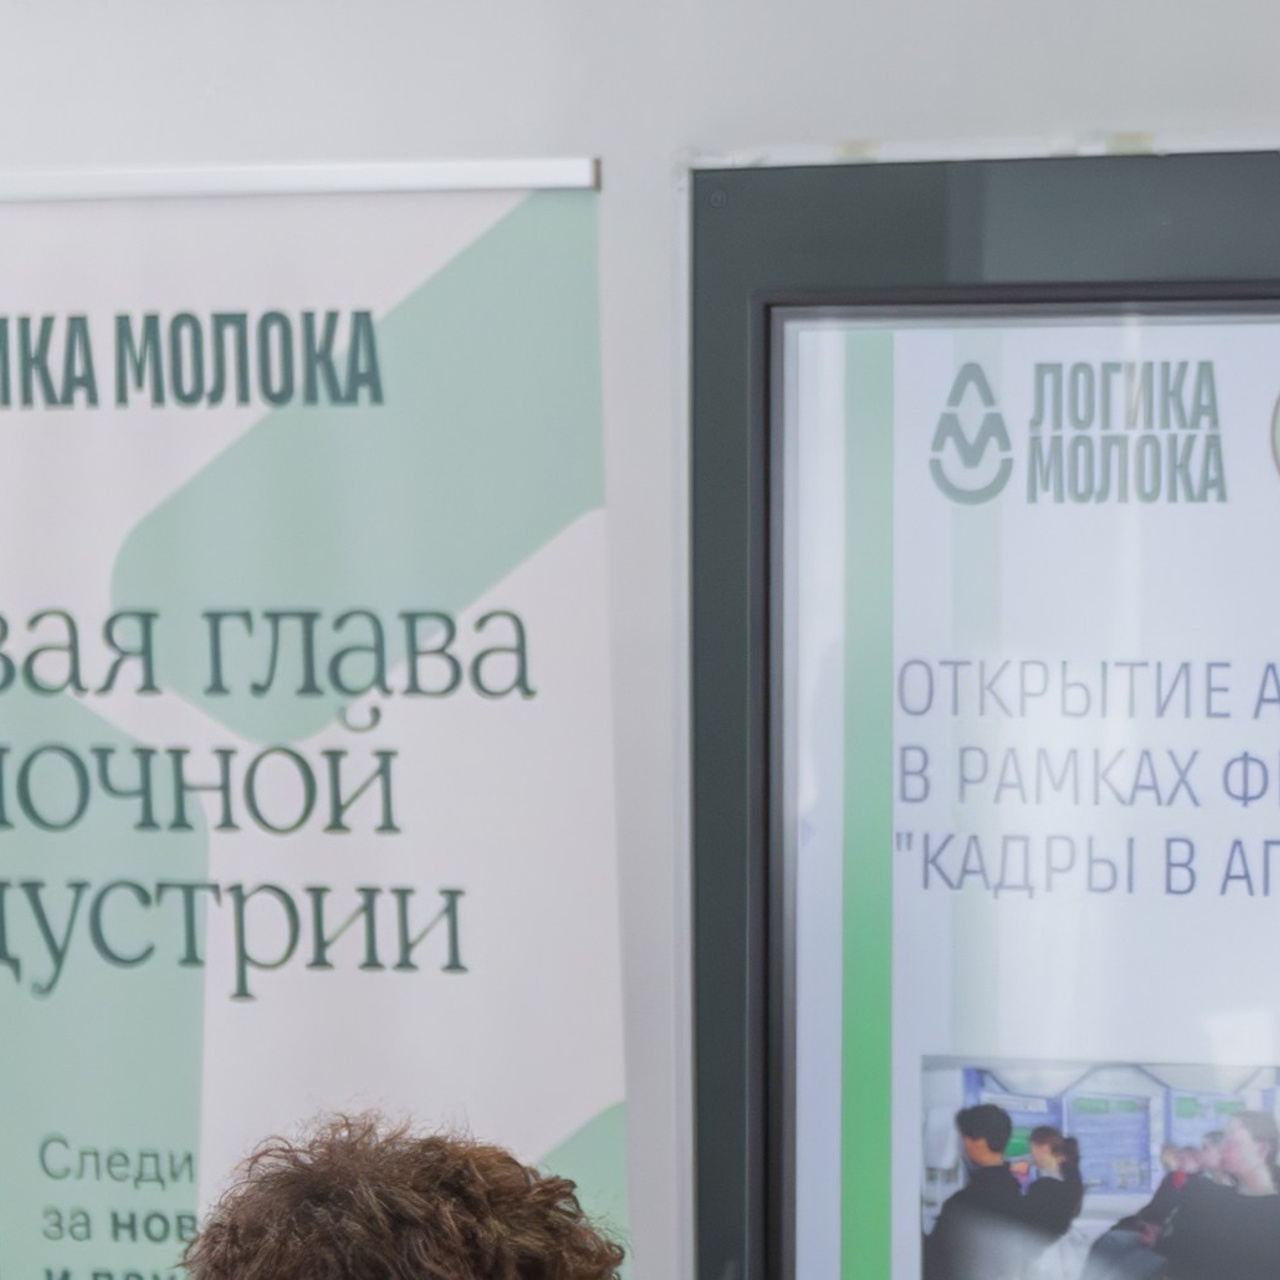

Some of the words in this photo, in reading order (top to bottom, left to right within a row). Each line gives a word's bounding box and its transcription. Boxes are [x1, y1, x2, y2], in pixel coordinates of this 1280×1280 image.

[0, 314, 98, 409] КА
[115, 310, 383, 408] МОЛОКА
[1029, 361, 1220, 430] ЛОГИКА
[1026, 433, 1227, 503] МОЛОКА
[0, 609, 162, 697] ая
[201, 609, 537, 700] глава
[899, 659, 1231, 719] ОТКРЫТИЕ
[0, 705, 402, 835] очной
[899, 745, 931, 804] В
[958, 746, 1201, 807] РАМКАХ
[895, 831, 1135, 900] "КАДРЫ
[1164, 836, 1197, 895] В
[39, 1134, 195, 1191] Следи
[42, 1207, 92, 1242] за
[110, 1209, 198, 1243] нов
